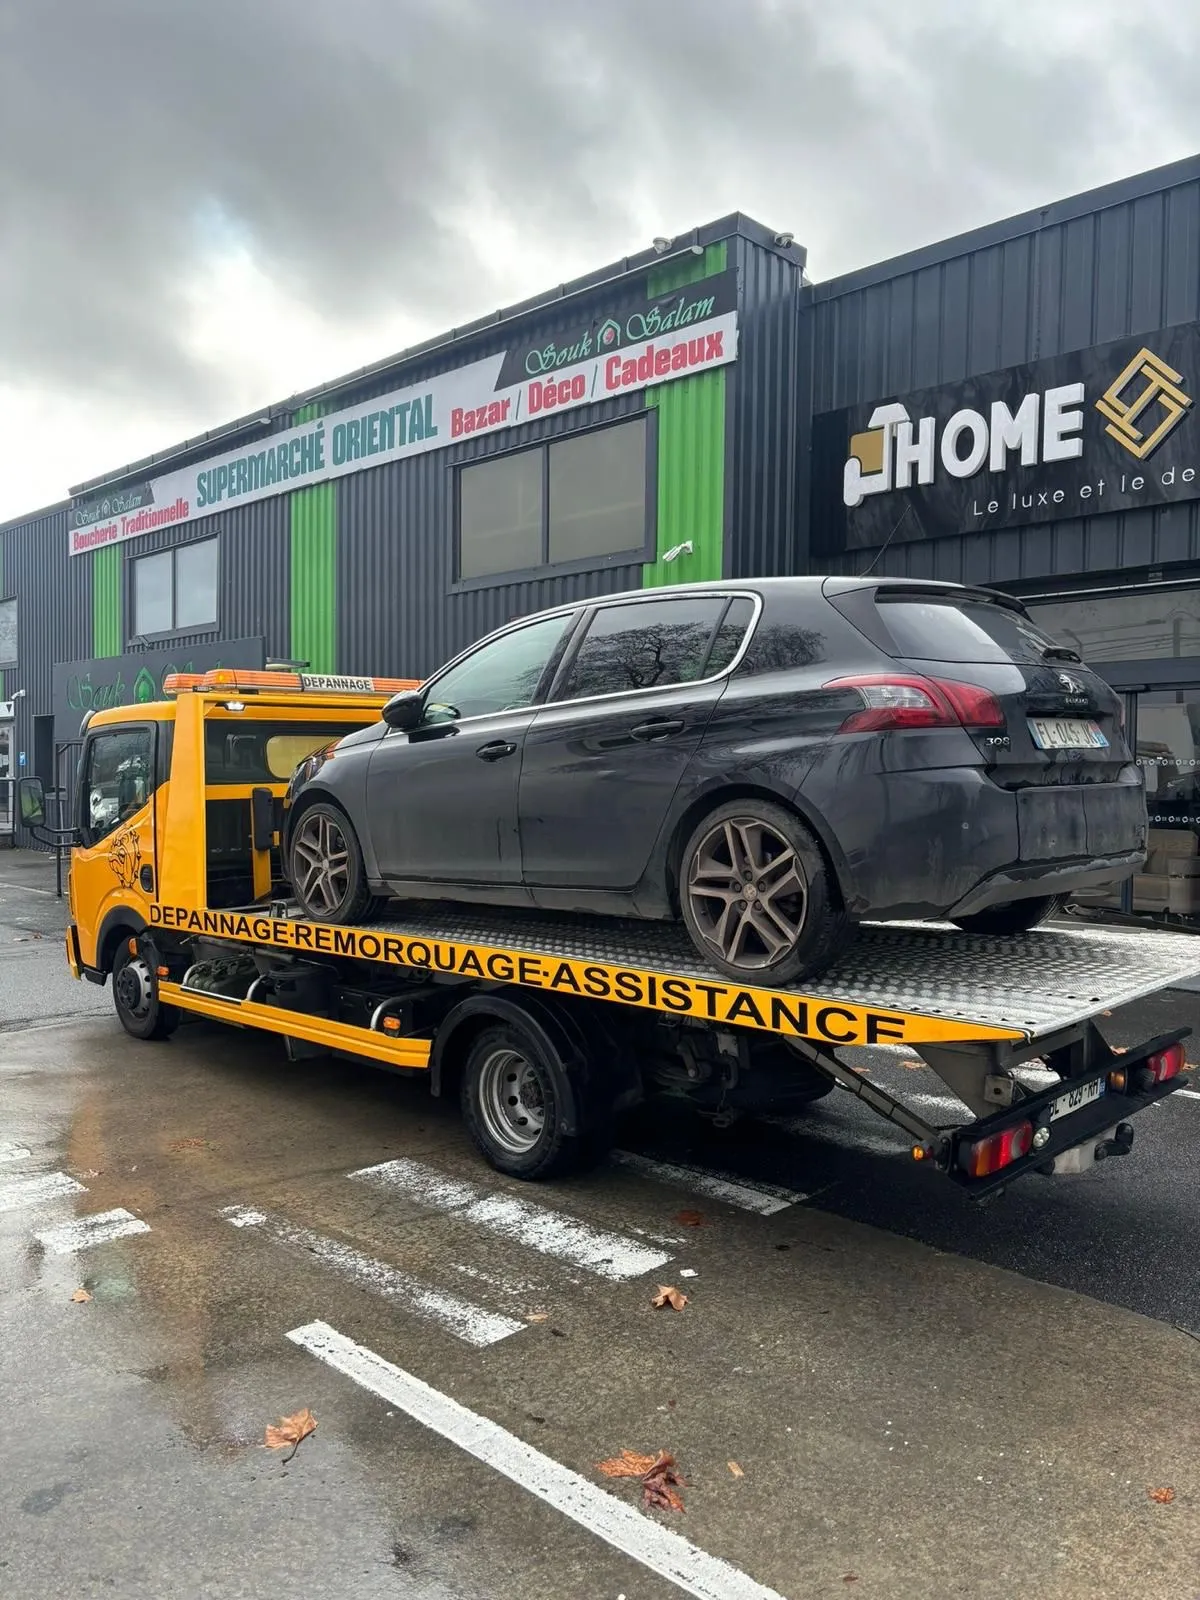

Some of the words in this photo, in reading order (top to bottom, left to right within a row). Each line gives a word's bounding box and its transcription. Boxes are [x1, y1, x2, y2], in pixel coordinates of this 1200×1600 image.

[525, 331, 593, 375] Souk
[626, 295, 715, 341] Salam
[451, 396, 510, 438] Bazar
[528, 376, 586, 415] Déco
[605, 330, 724, 391] Cadeaux
[196, 420, 326, 508] SUPERMARCHÉ
[332, 394, 438, 466] ORIENTAL
[973, 499, 999, 516] Le
[1012, 488, 1065, 510] luxe
[1079, 477, 1106, 500] et
[1120, 474, 1145, 493] le
[73, 520, 118, 551] Boucherie
[121, 497, 189, 537] Traditionnelle
[303, 677, 372, 690] DEPANNAGE
[984, 736, 1010, 746] 308
